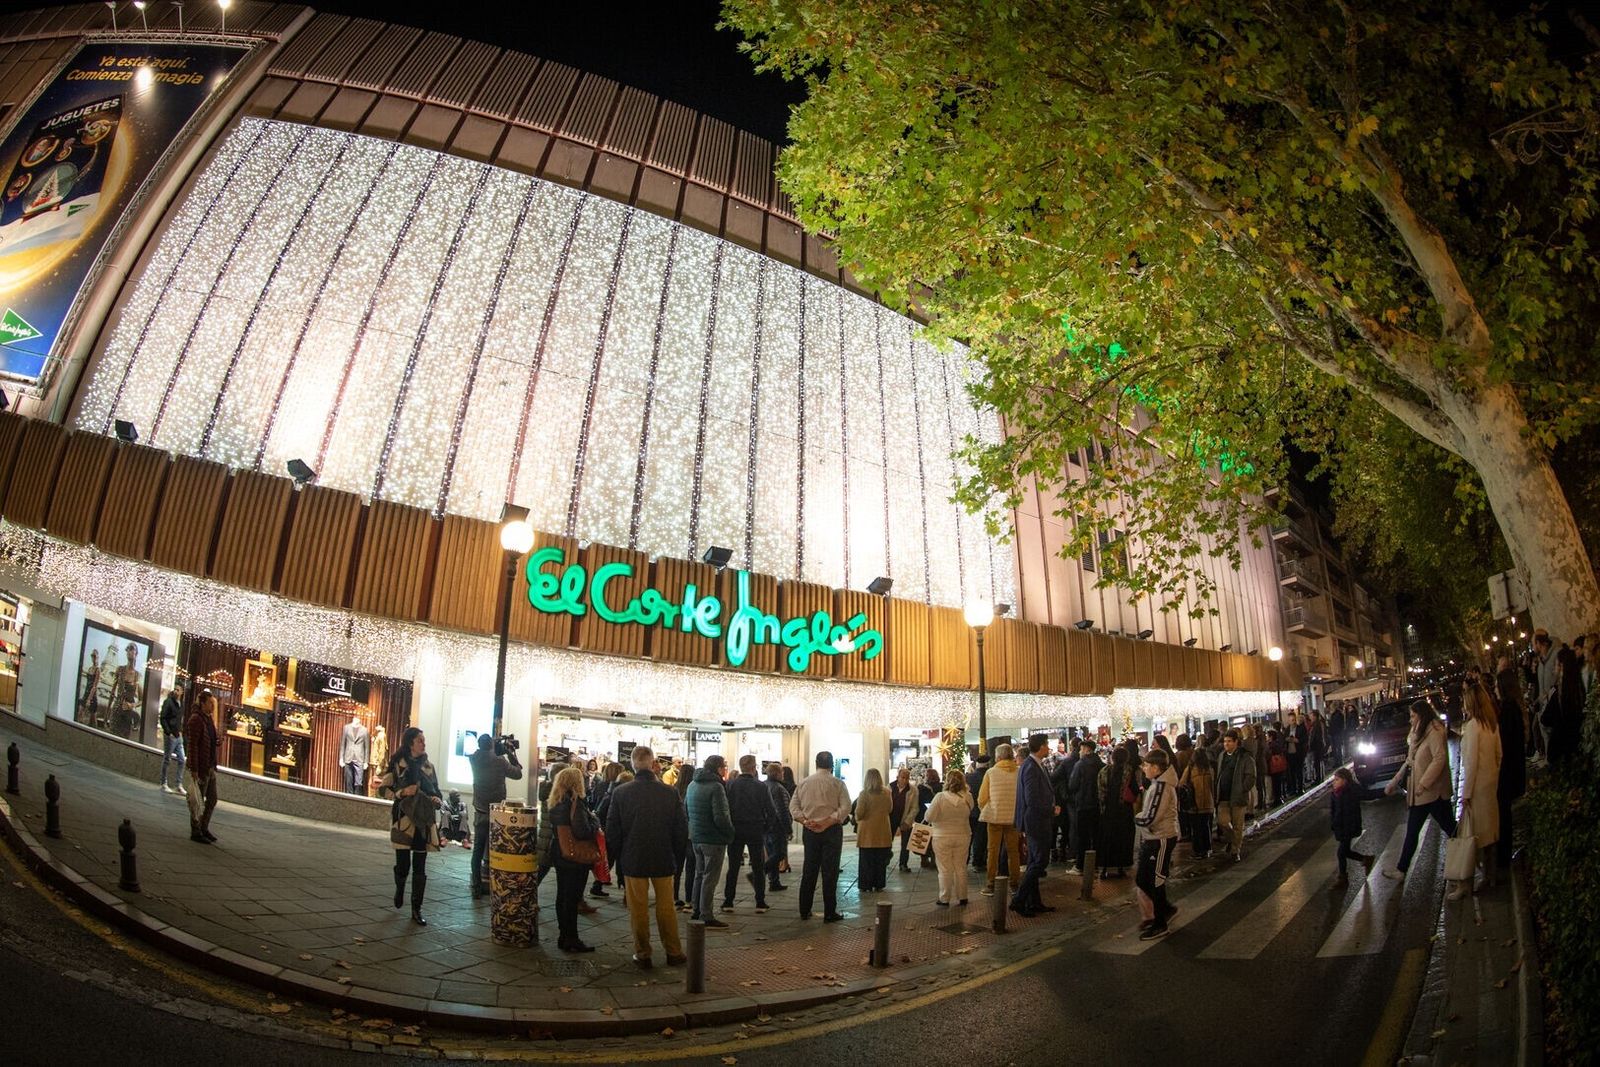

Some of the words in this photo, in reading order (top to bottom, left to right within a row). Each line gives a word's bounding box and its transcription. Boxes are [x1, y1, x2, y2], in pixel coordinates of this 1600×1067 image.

[99, 56, 115, 67] Ya
[117, 56, 148, 67] está
[150, 57, 188, 70] aquí.
[66, 69, 133, 81] Comienza
[153, 71, 204, 86] magia
[41, 98, 120, 130] JUGUETES
[525, 546, 587, 616] El
[589, 561, 722, 638] Corte
[724, 569, 883, 673] Inglés
[328, 676, 346, 691] CH
